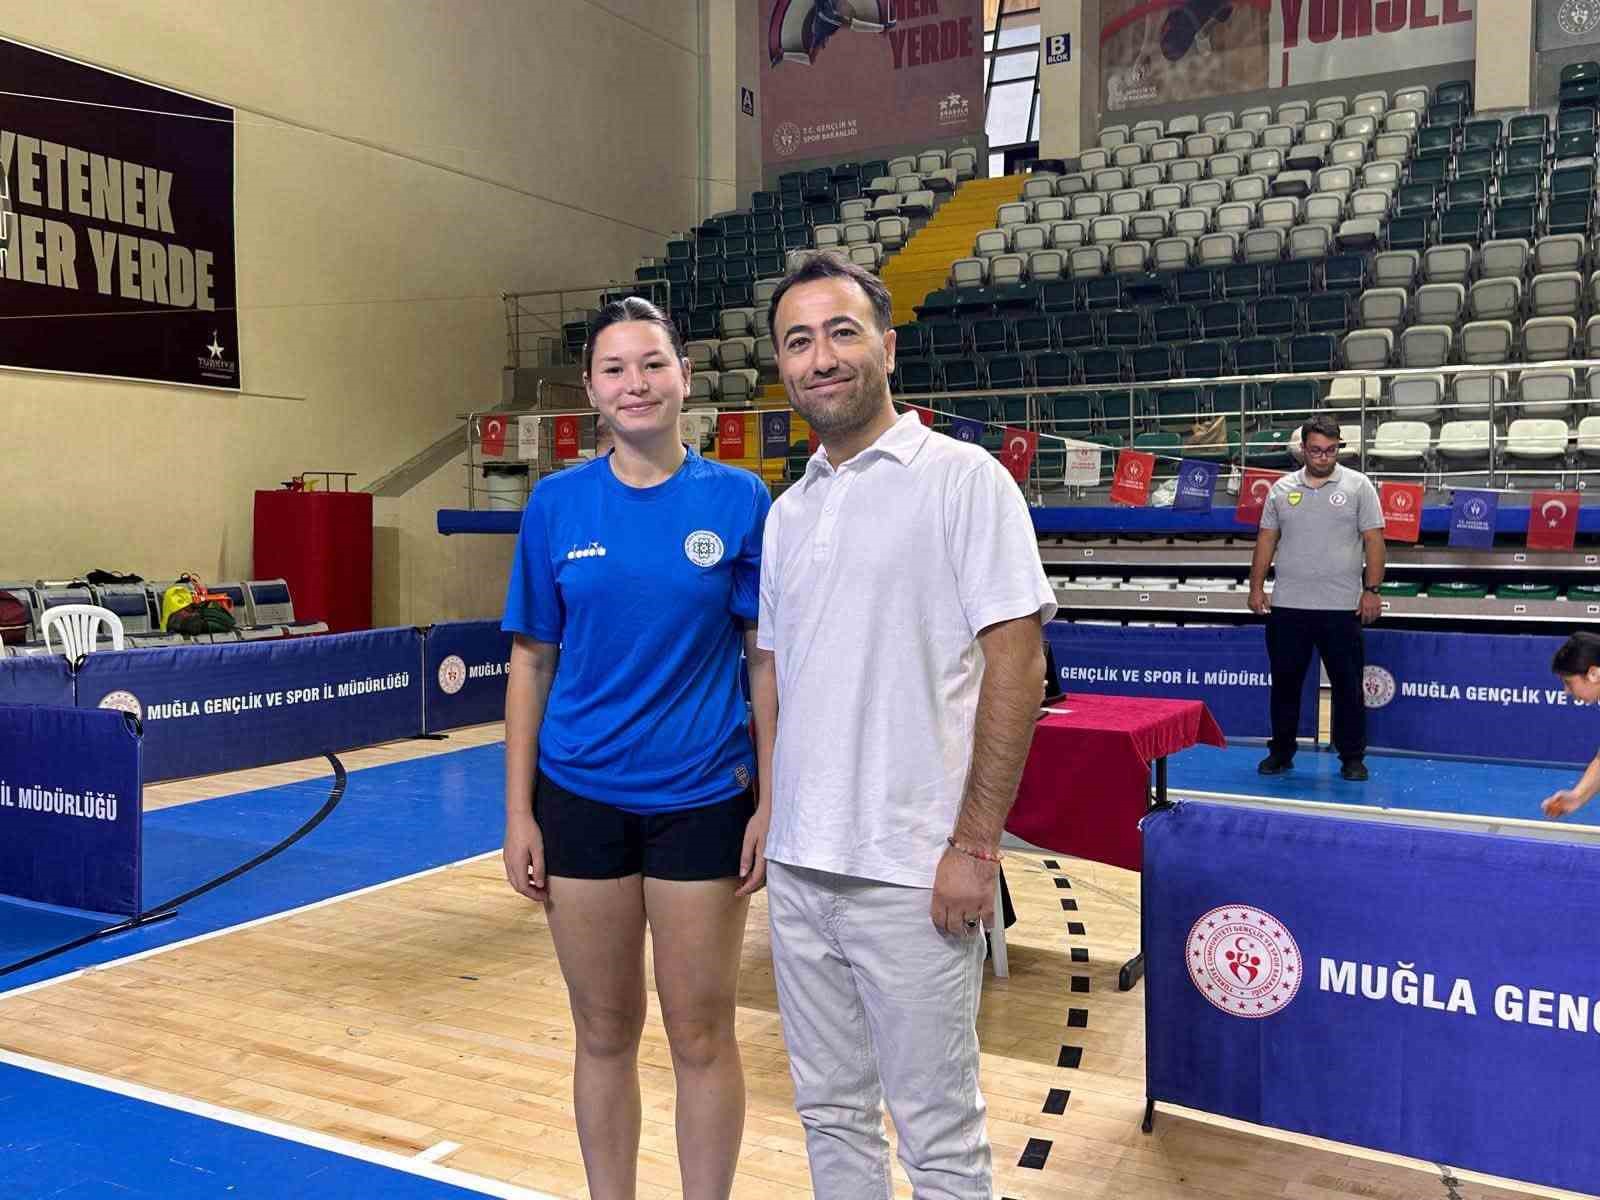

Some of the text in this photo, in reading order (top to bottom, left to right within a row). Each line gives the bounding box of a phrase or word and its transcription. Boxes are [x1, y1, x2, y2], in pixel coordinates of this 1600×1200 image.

[888, 17, 973, 69] YERDE
[1048, 54, 1069, 64] BLOK
[1051, 36, 1065, 55] B
[87, 227, 215, 312] YERDE
[469, 662, 502, 678] MUĞLA
[1060, 666, 1118, 684] GENÇLİK
[1122, 669, 1139, 682] VE
[1143, 670, 1182, 685] SPOR
[1186, 668, 1200, 685] İL
[147, 672, 409, 720] MUĞLA GENÇLİK VE SPOR İL MÜDÜRLÜĞÜ
[1401, 681, 1461, 699] MUĞLA
[1465, 685, 1540, 706] GENÇLİK
[1544, 690, 1567, 705] VE
[0, 780, 117, 821] İL MÜDÜRLÜĞÜ
[1319, 957, 1600, 1037] MUĞLA GEN
